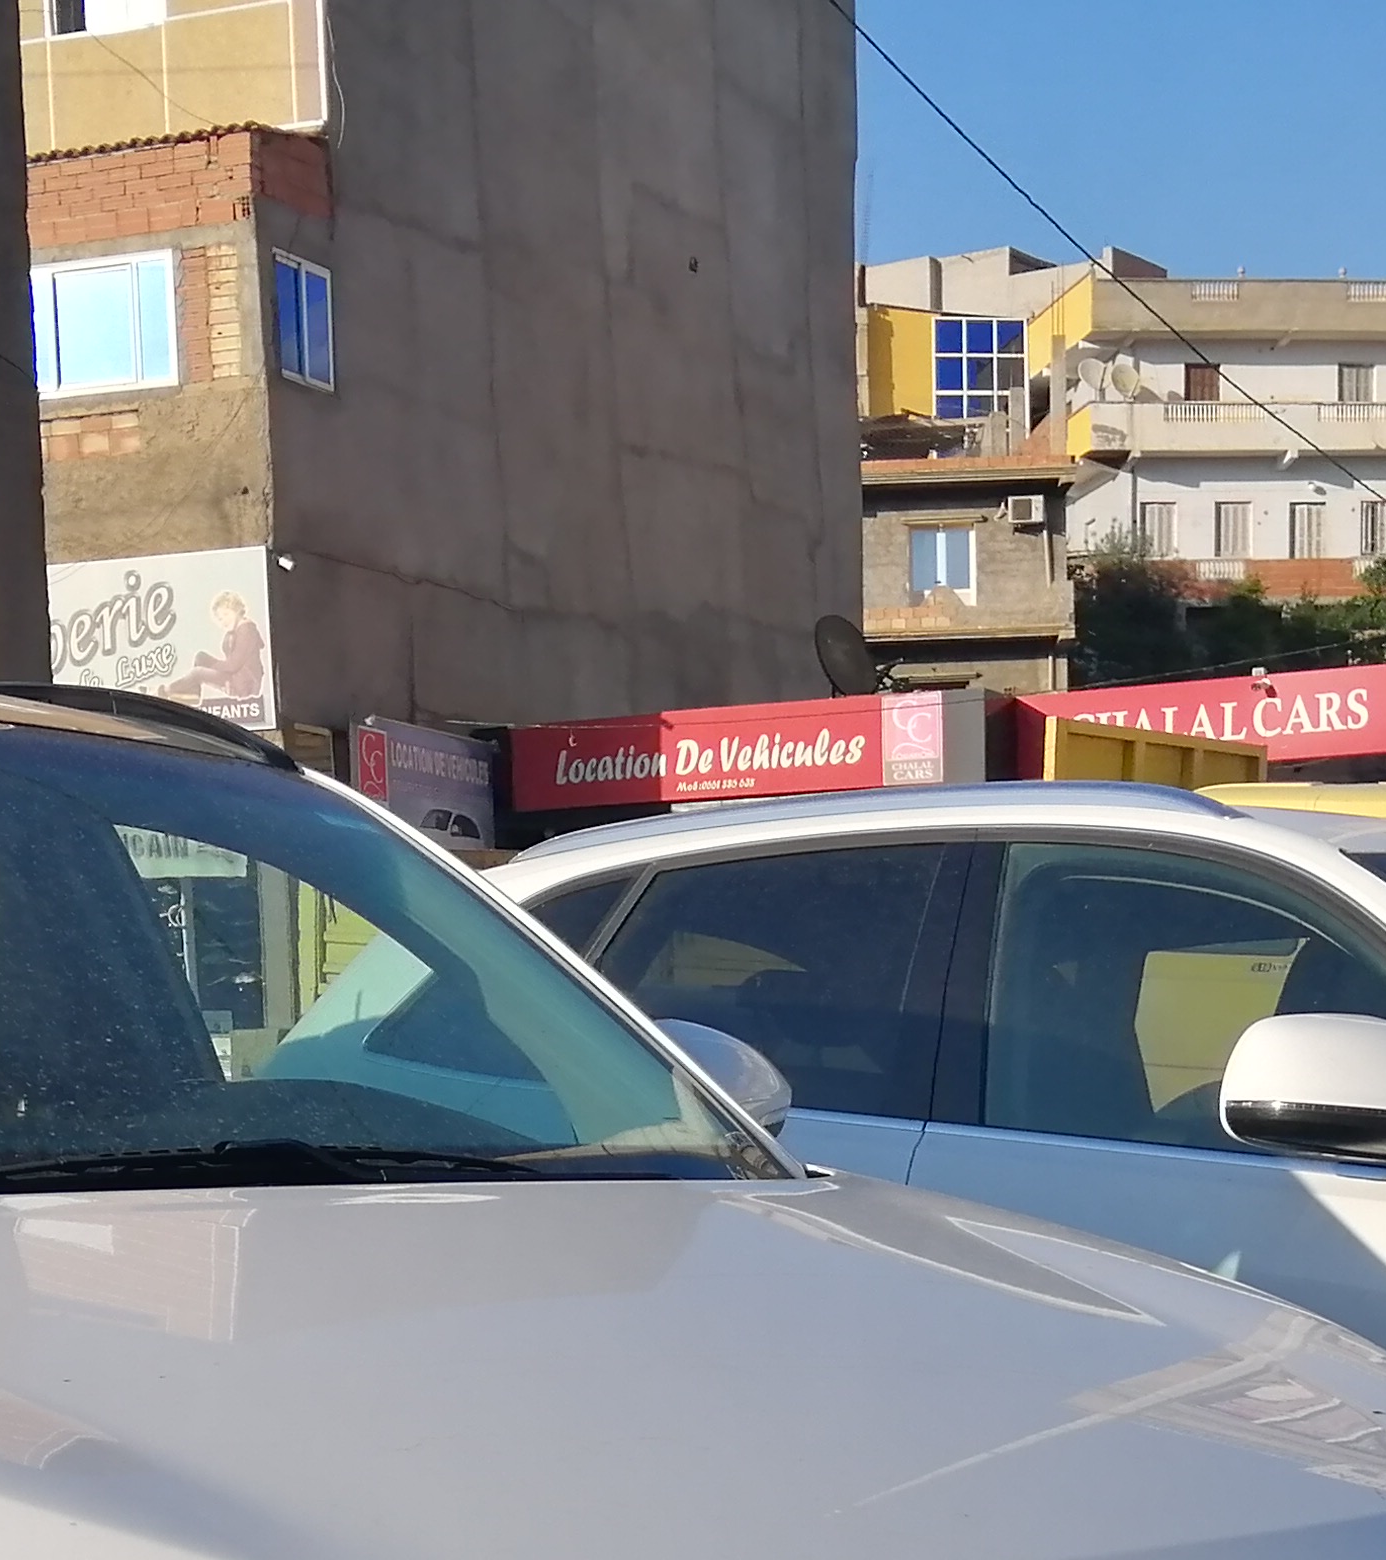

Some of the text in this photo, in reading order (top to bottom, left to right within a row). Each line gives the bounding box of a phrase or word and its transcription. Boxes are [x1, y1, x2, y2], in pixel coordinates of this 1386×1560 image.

[116, 644, 177, 687] Luxe
[1073, 688, 1369, 741] ALAL CARS
[390, 740, 433, 774] LOCATION
[434, 751, 446, 778] DE
[555, 728, 865, 785] Location De Vehicules
[892, 761, 934, 771] CHALAL
[893, 769, 934, 780] CARS
